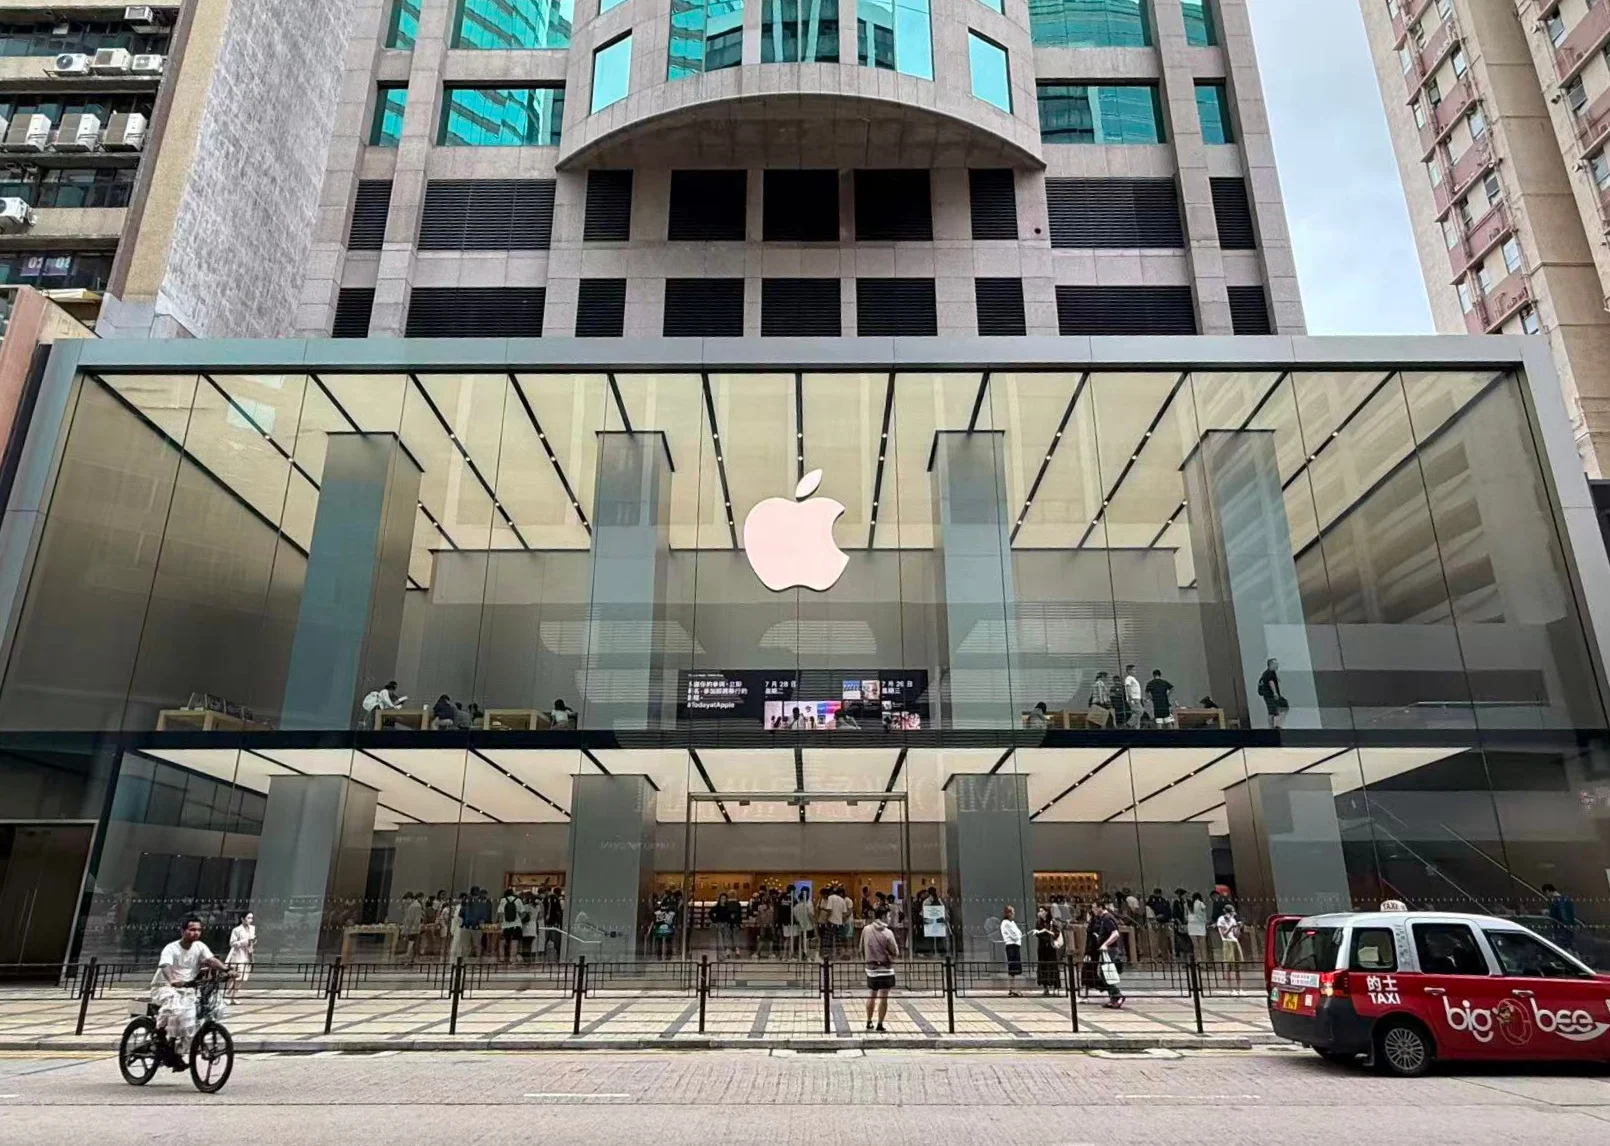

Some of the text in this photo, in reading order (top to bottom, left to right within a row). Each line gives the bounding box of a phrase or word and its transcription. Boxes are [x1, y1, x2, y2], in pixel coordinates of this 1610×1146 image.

[1366, 975, 1398, 991] 的士
[1368, 992, 1401, 1005] TAXI
[1442, 995, 1594, 1043] big bee
